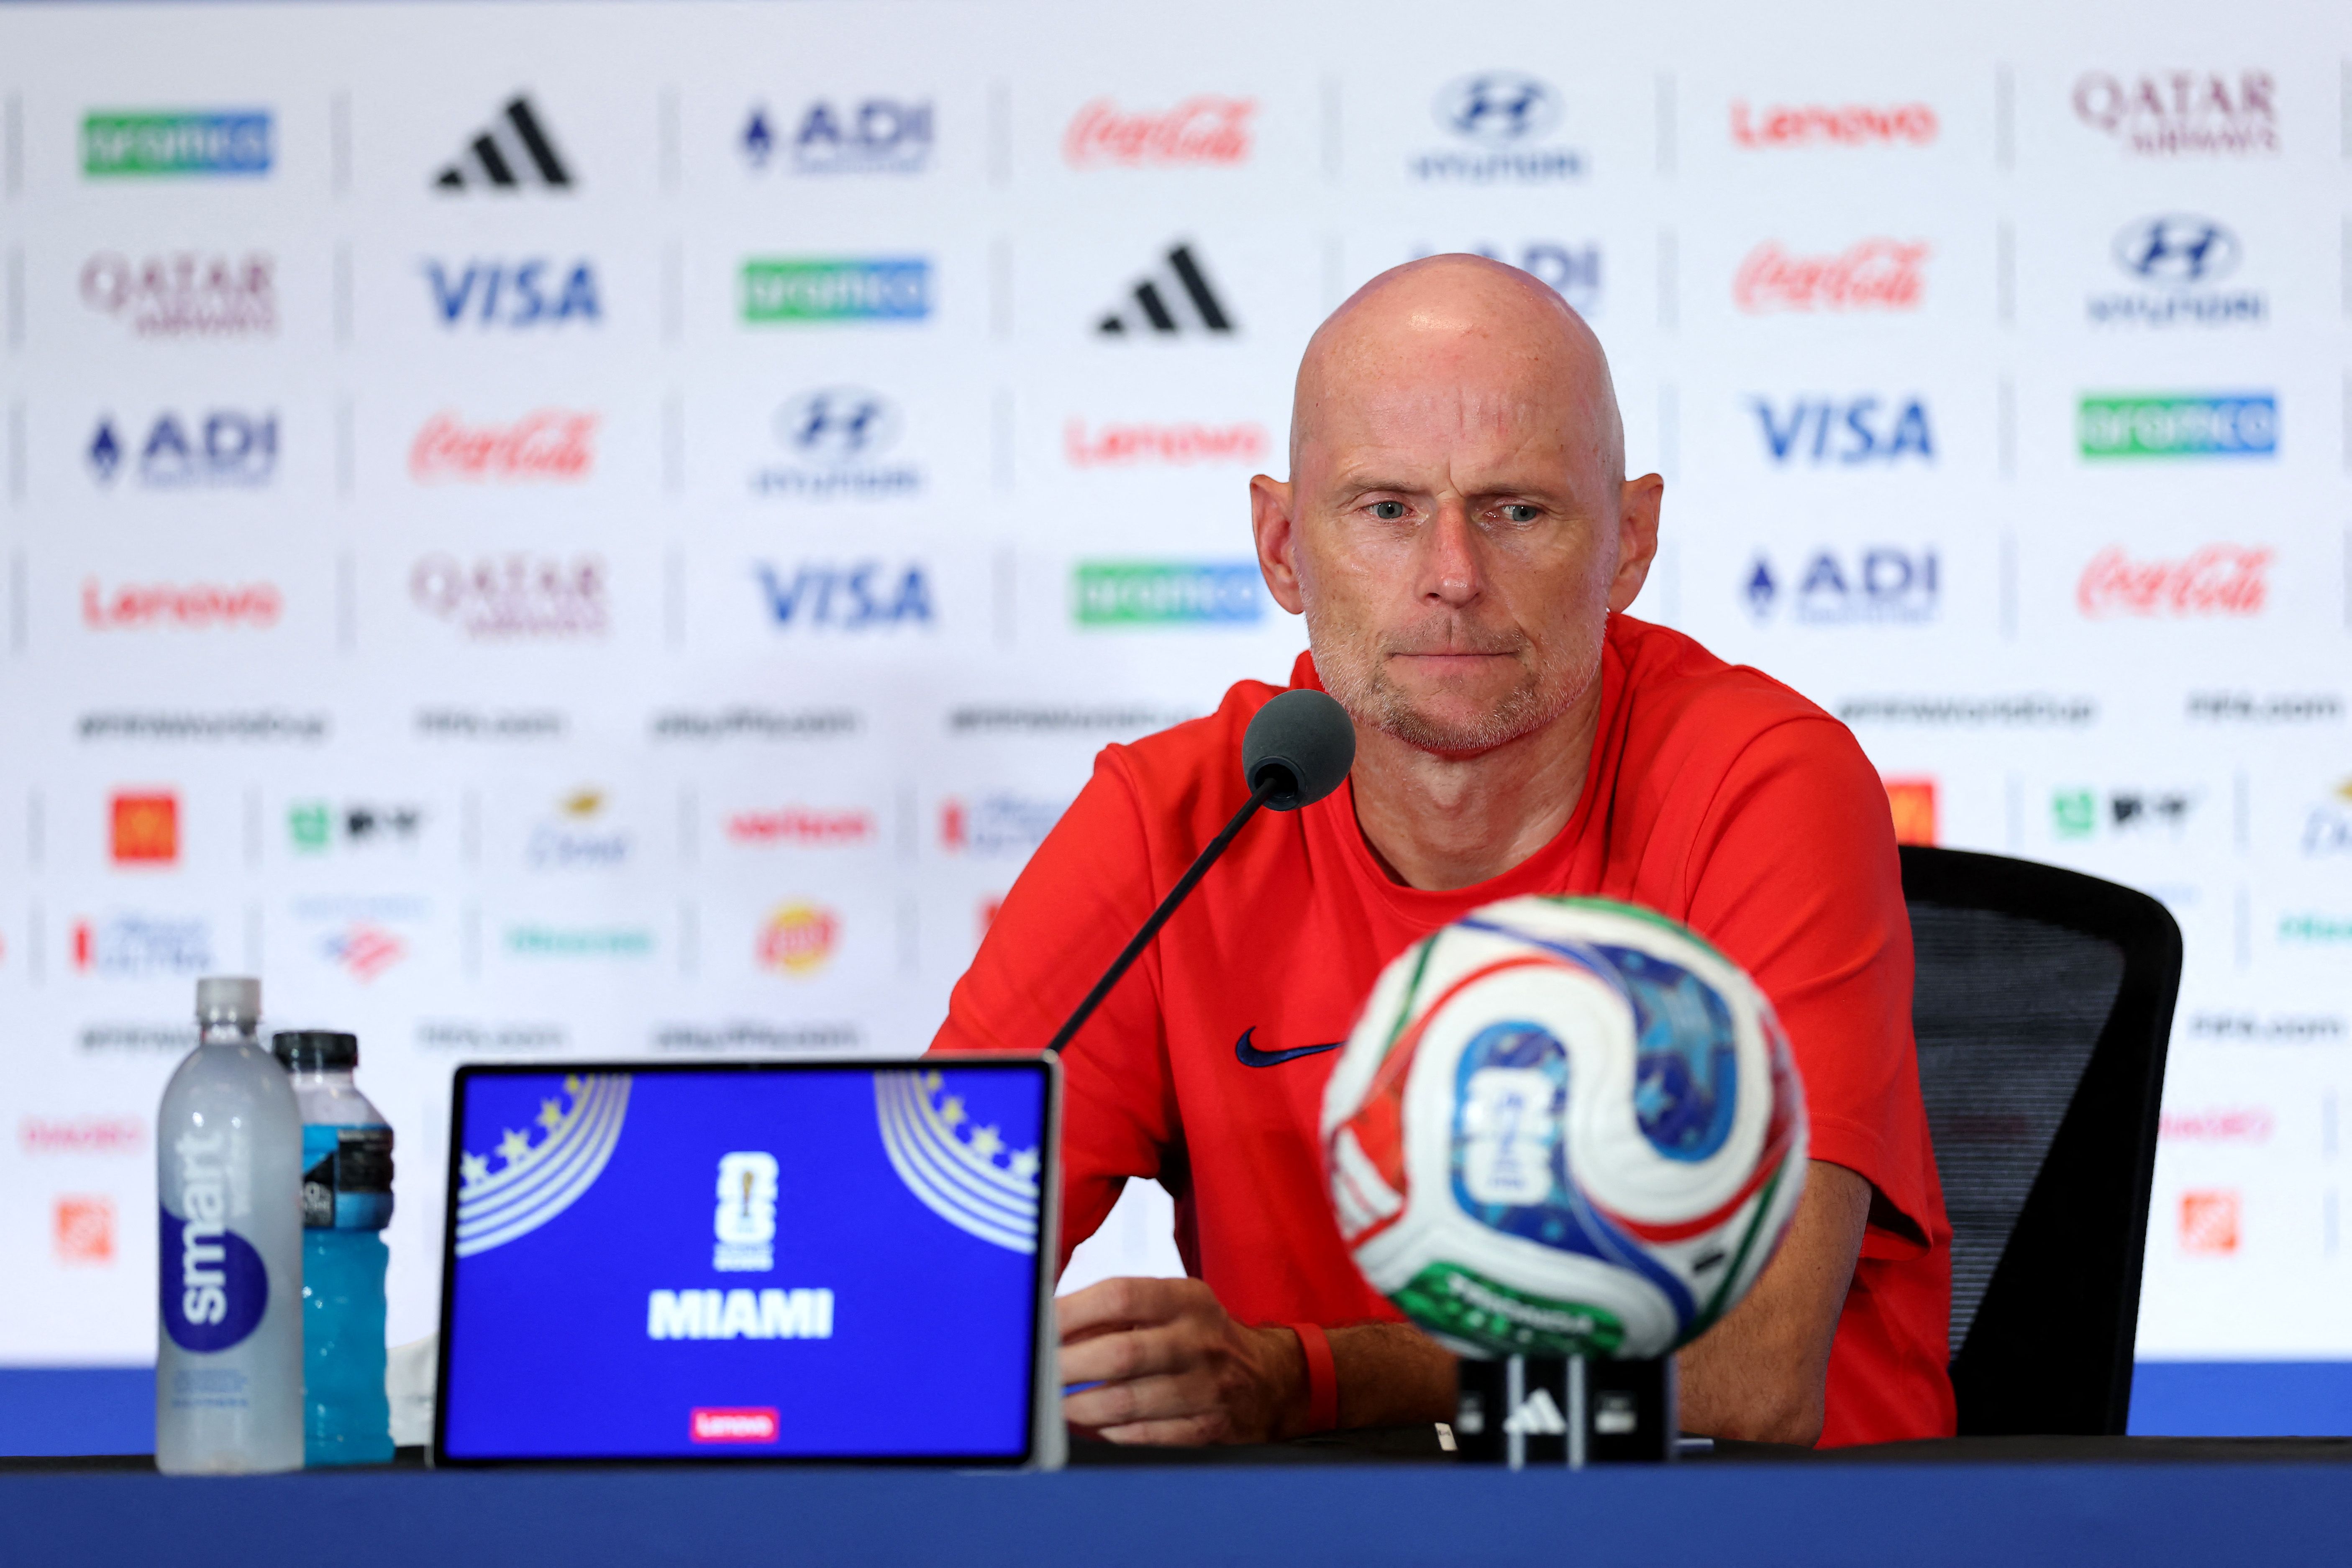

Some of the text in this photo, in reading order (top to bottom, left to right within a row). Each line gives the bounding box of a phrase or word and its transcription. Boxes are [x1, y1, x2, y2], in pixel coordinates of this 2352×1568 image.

[792, 99, 933, 146] ADI
[1064, 97, 1255, 166] Coca-Cola
[1731, 103, 1938, 148] Lenovo
[2072, 70, 2277, 134] QATAR
[78, 252, 275, 316] QATAR
[423, 257, 602, 329] VISA
[1733, 238, 1929, 312] Coca-Cola
[138, 409, 280, 464] ADI
[408, 410, 597, 481] Coca-Cola
[1065, 418, 1270, 464] Lenovo
[1752, 394, 1937, 465] VISA
[2088, 400, 2278, 451] aramco
[81, 578, 282, 630] Lenovo
[755, 559, 938, 633] VISA
[1796, 546, 1940, 599] ADI
[2076, 545, 2273, 617] Coca-Cola
[176, 1130, 227, 1325] smart
[647, 1288, 834, 1340] MIAMI
[695, 1412, 774, 1438] Lenovo
